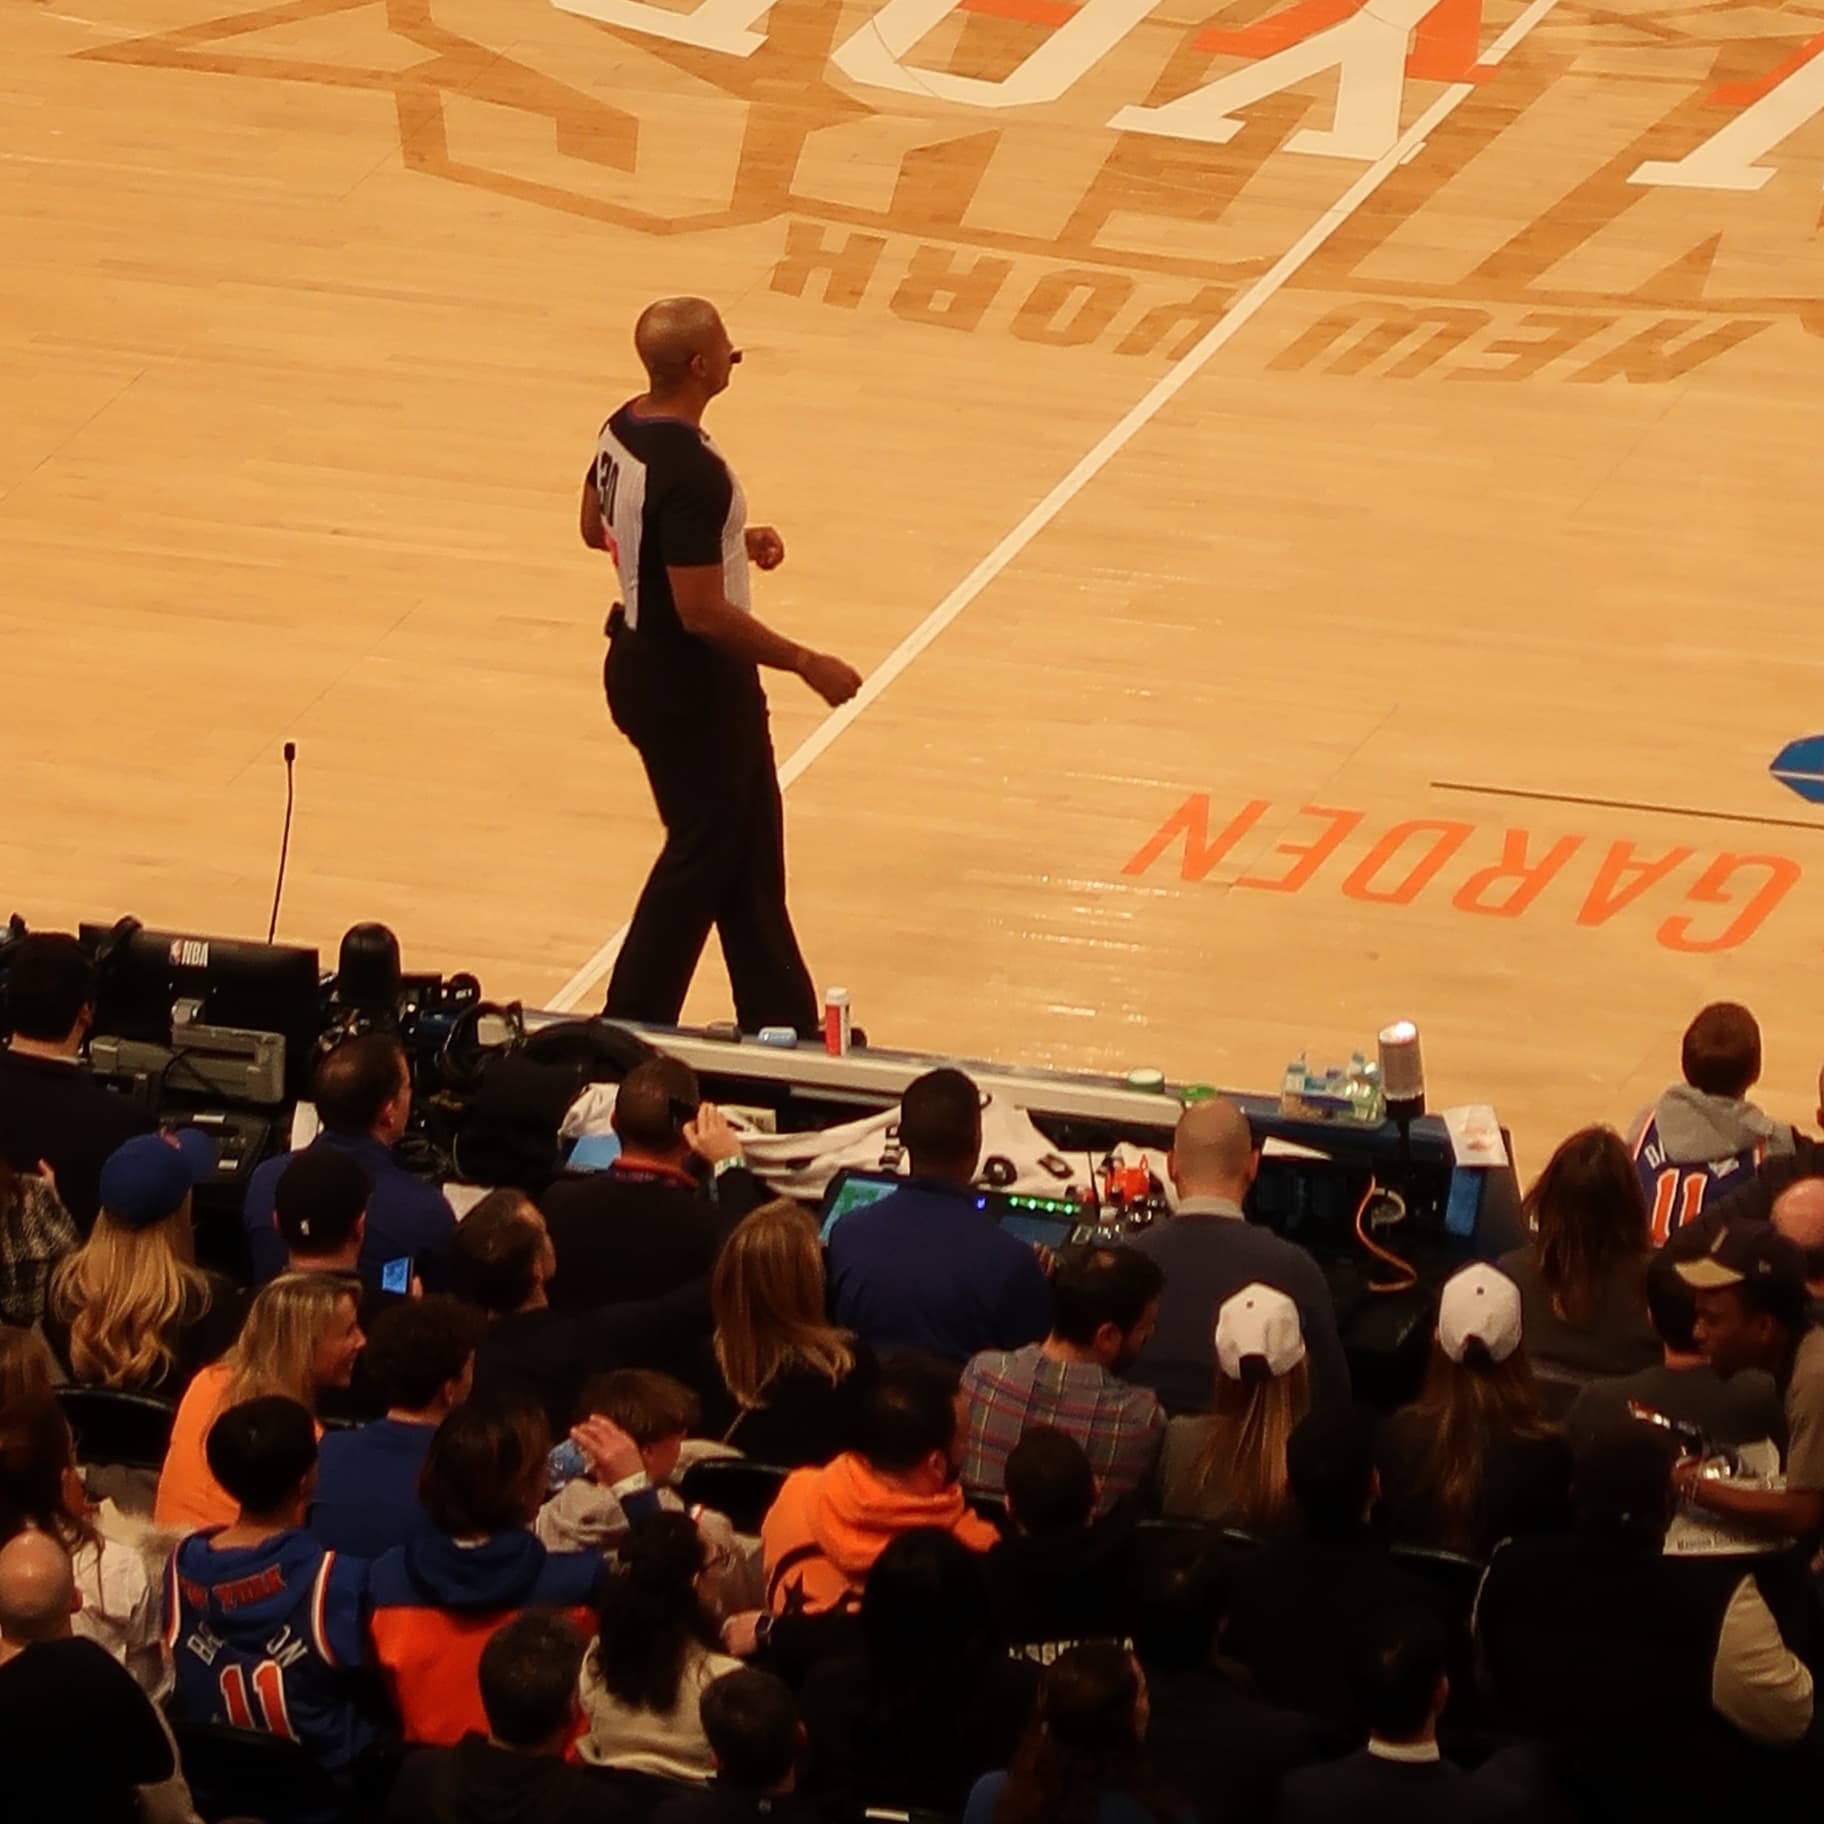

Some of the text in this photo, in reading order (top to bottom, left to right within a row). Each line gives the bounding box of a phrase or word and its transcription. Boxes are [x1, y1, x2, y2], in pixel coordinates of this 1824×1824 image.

[1264, 298, 1778, 385] NEW
[1122, 791, 1803, 954] GARDEN
[181, 939, 209, 969] NBA
[1656, 1167, 1709, 1249] 11
[219, 1658, 303, 1747] 11
